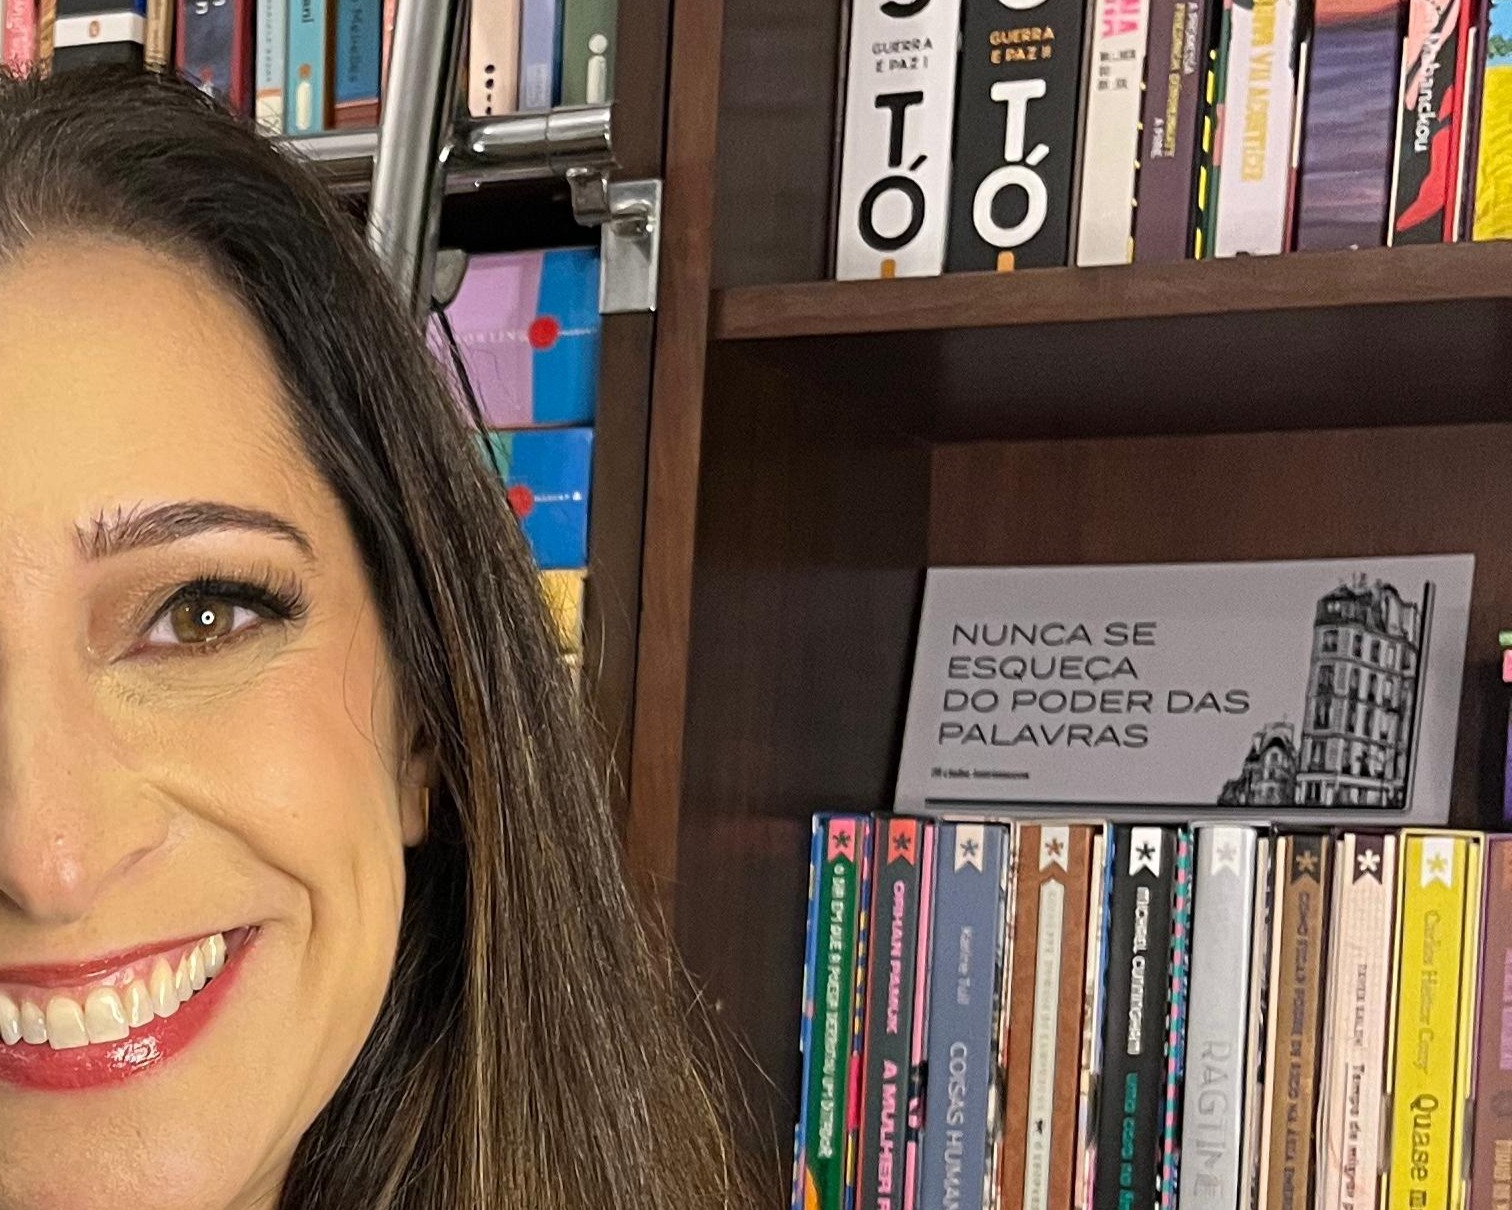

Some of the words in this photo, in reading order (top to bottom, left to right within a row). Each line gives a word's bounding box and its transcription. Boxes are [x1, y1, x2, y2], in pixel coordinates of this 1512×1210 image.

[872, 37, 933, 54] GUERRA
[989, 25, 1055, 46] GUERRA
[990, 49, 1002, 64] E
[1005, 46, 1037, 62] PAZ
[876, 59, 884, 73] E
[889, 56, 919, 70] PAZ
[953, 621, 1092, 647] NUNCA
[1104, 621, 1157, 647] SE
[947, 655, 1138, 683] ESQUEÇA
[943, 688, 999, 714] DO
[1011, 688, 1153, 714] PODER
[1166, 688, 1250, 714] DAS
[938, 721, 1149, 748] PALAVRAS
[830, 901, 844, 922] EM
[889, 880, 906, 955] ORHAN
[1131, 886, 1150, 951] MICHAEL
[1297, 892, 1311, 936] COMO
[829, 925, 843, 950] QUE
[957, 926, 974, 975] Karine
[1421, 910, 1441, 965] Carlos
[826, 965, 841, 1008] POESIA
[886, 960, 903, 1034] PAMUK
[956, 978, 972, 1006] Tuil
[1127, 955, 1147, 1055] CUNNINGHAM
[1418, 970, 1438, 1024] Heitor
[881, 1060, 898, 1078] A
[1413, 1028, 1434, 1075] Cony
[945, 1041, 968, 1125] COISAS
[1348, 1064, 1366, 1116] Tempo
[877, 1083, 899, 1192] MULHER
[1196, 1041, 1231, 1198] RAGTIME
[1349, 1120, 1363, 1141] de
[1409, 1093, 1439, 1182] Quase
[1343, 1145, 1361, 1198] migrar
